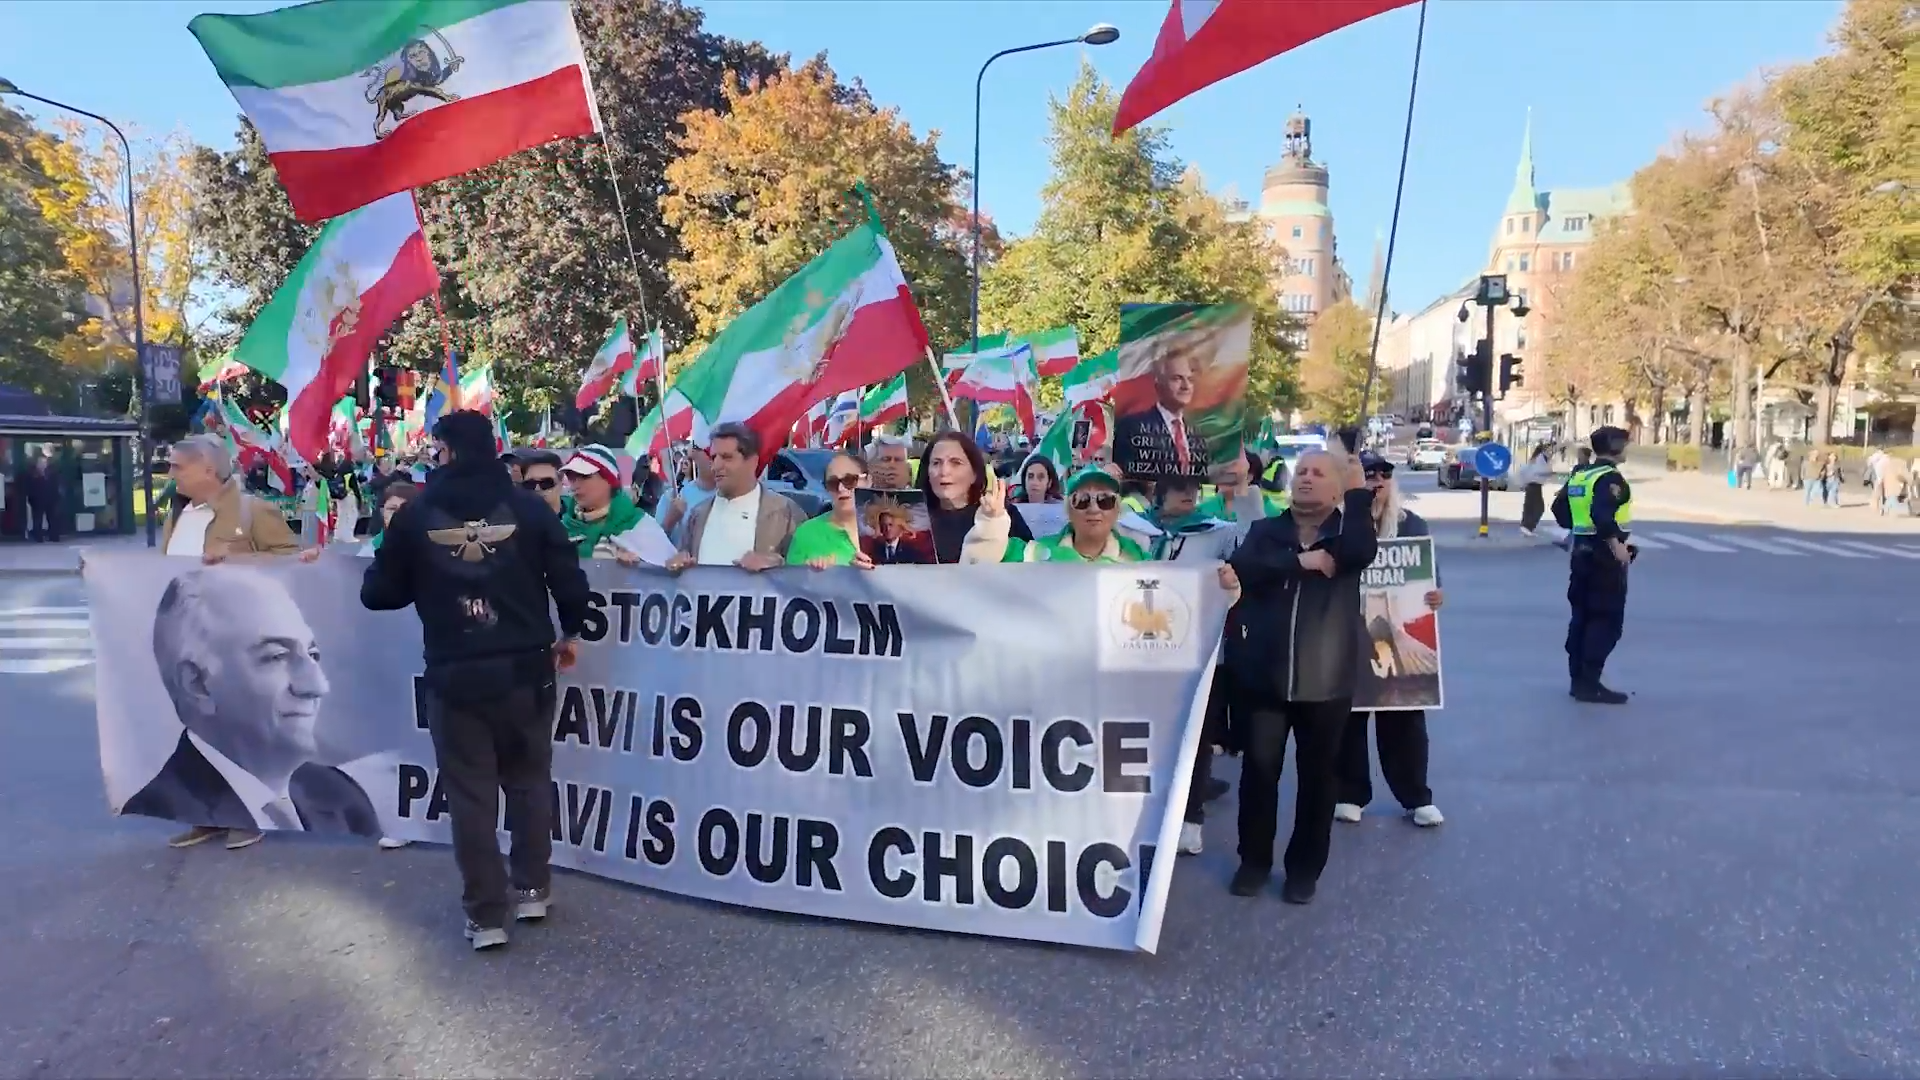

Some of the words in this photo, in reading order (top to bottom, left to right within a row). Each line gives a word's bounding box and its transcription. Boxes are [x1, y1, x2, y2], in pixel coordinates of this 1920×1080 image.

[1128, 461, 1161, 474] REZA
[1366, 568, 1405, 585] IRAN
[580, 590, 904, 658] STOCKHOLM
[652, 695, 703, 762] IS
[727, 701, 873, 778] OUR
[897, 712, 1152, 793] VOICE
[625, 795, 675, 865] IS
[698, 808, 842, 891] OUR
